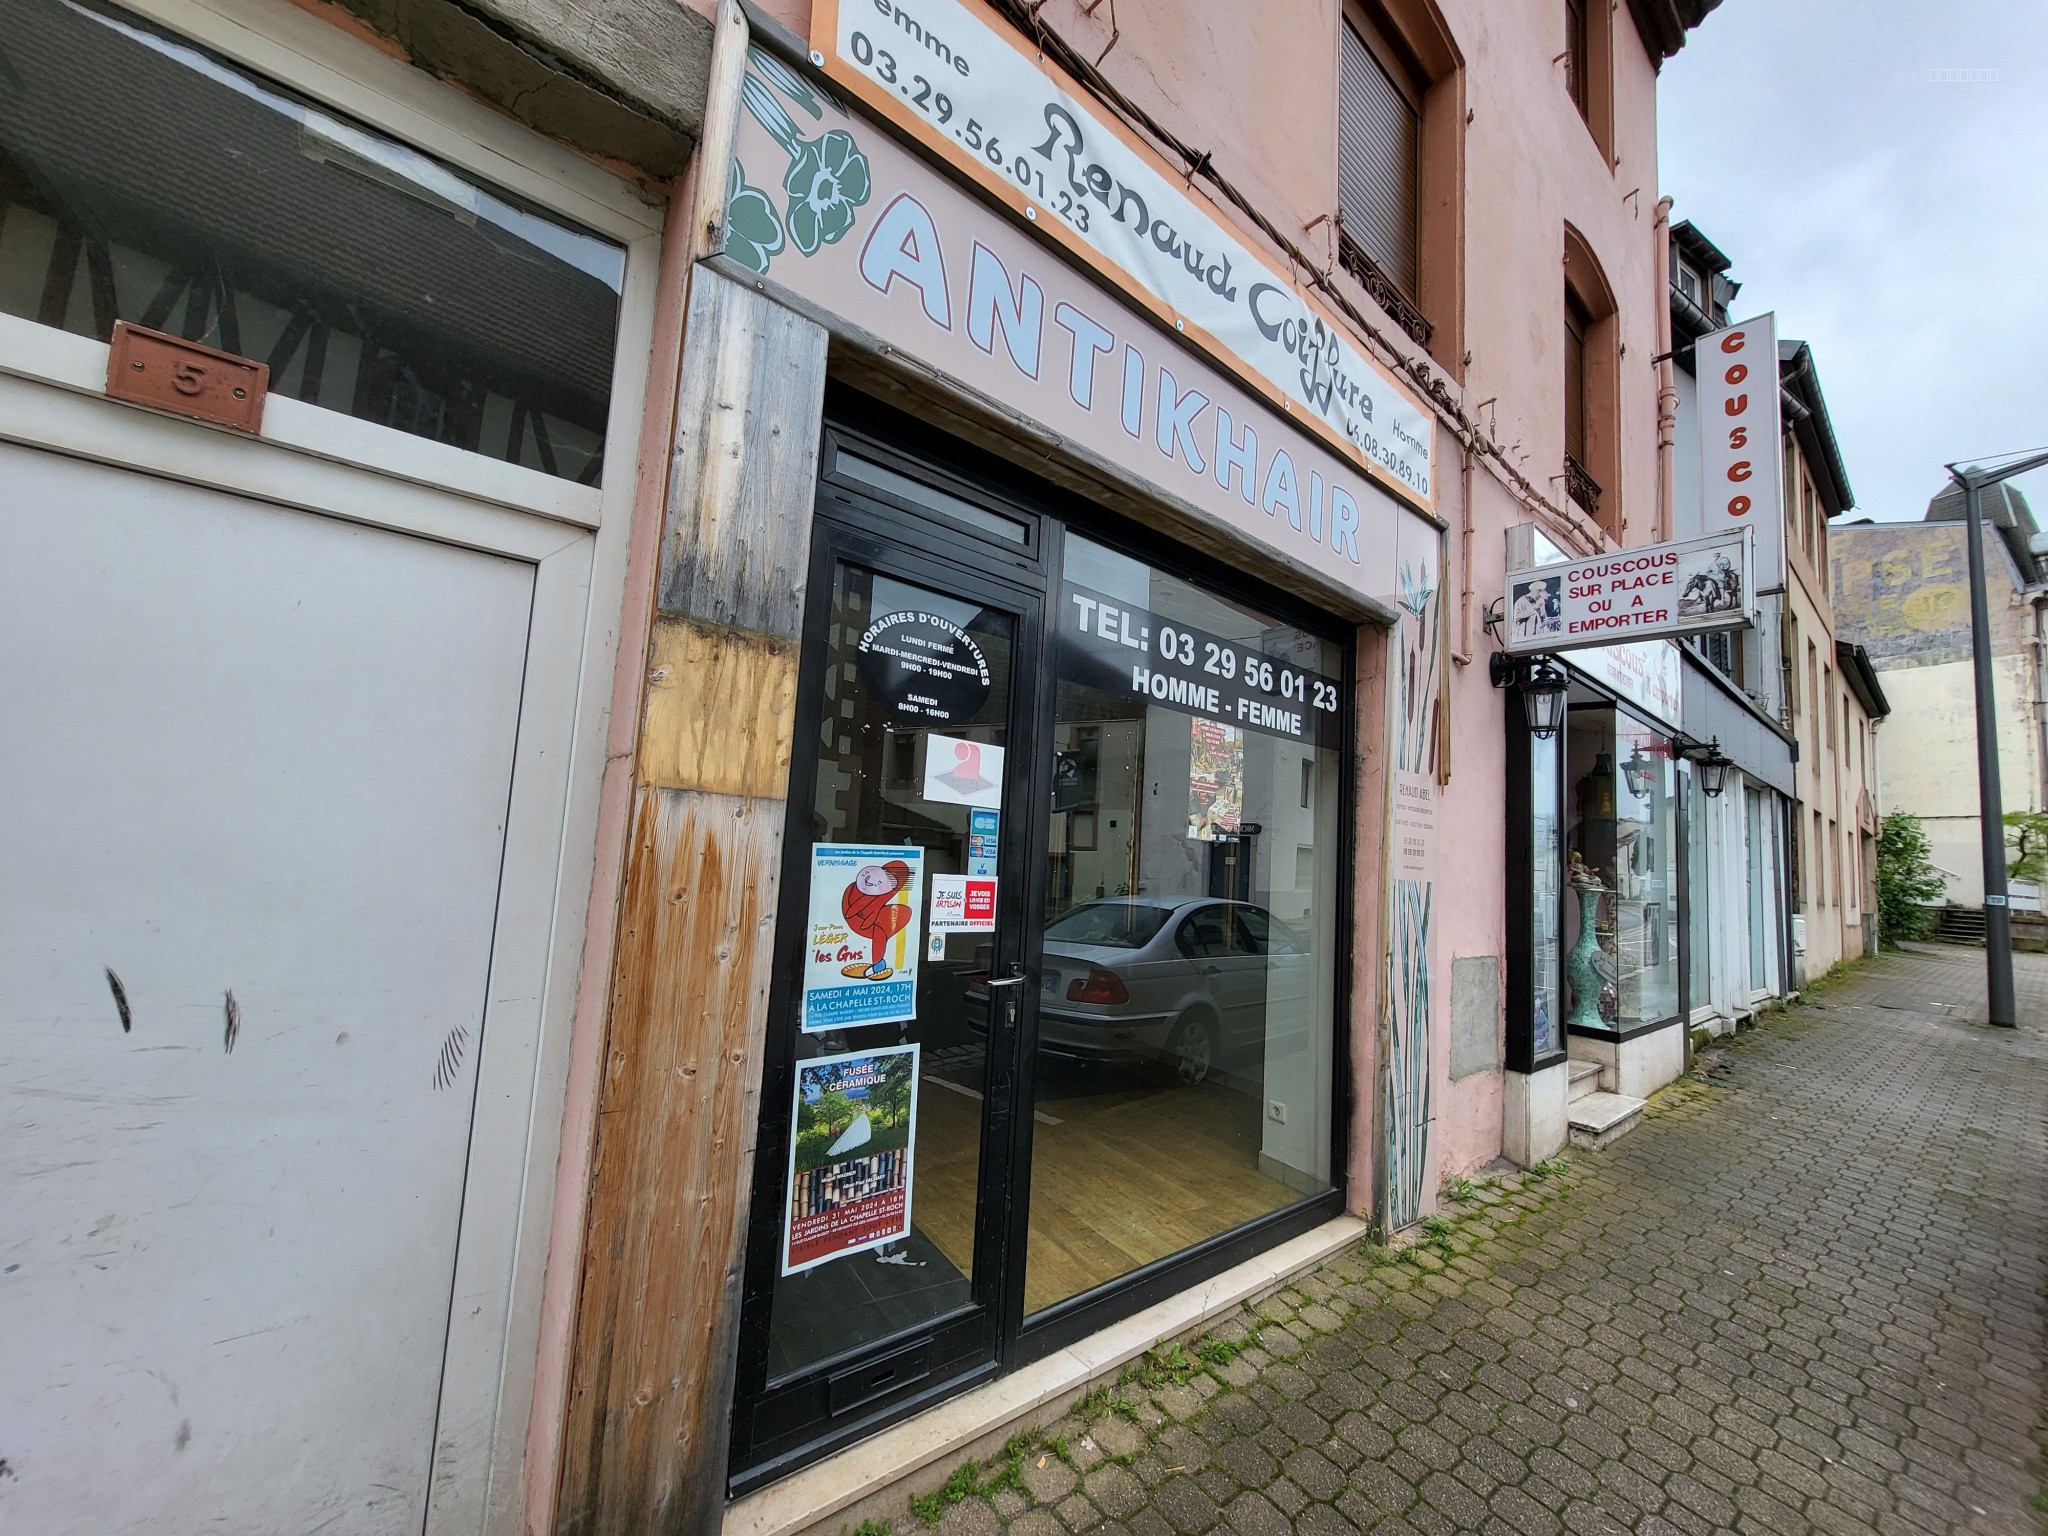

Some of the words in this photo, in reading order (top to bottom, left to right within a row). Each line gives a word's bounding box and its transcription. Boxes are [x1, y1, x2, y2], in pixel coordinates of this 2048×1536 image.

[1030, 103, 1237, 302] Renaud
[172, 360, 208, 396] 5
[858, 191, 1360, 564] ANTIKHAIR
[1392, 418, 1428, 460] Homme
[1568, 552, 1677, 582] COUSCOUS
[1568, 584, 1602, 599] SUR
[1611, 571, 1674, 592] PLACE
[1588, 599, 1612, 613] OU
[1631, 595, 1644, 607] A
[1569, 609, 1668, 634] EMPORTER
[859, 612, 915, 653] HORAIRES
[919, 612, 990, 686] D'OUVERTURES
[901, 634, 926, 647] LUNDI
[928, 641, 954, 655] FERMÉ
[1072, 593, 1149, 652] TEL:
[1159, 626, 1195, 667] 03
[1204, 642, 1236, 680] 29
[1244, 656, 1273, 692] 56
[1280, 669, 1304, 702] 01
[1313, 681, 1338, 712] 23
[872, 644, 978, 676] MARDI-MERCREDI-VENDREDI
[901, 661, 922, 673] 9H00
[928, 668, 953, 680] 19H00
[898, 703, 918, 713] 8H00
[925, 708, 950, 719] 16H00
[907, 693, 938, 706] SAMEDI
[1132, 665, 1219, 714] HOMME
[1237, 697, 1302, 736] FEMME
[817, 859, 858, 867] VERNISSAGE
[809, 990, 842, 1001] SAMEDI
[845, 989, 850, 997] 4
[852, 987, 869, 996] MAI
[870, 985, 893, 995] 2024,
[896, 983, 911, 992] 17H
[816, 1003, 828, 1012] LA
[829, 997, 872, 1010] CHAPELLE
[873, 994, 911, 1005] ST-ROCH
[829, 1074, 887, 1092] CÉRAMIQUE
[843, 1064, 874, 1077] FUSÉE
[792, 1215, 829, 1231] VENDREDI
[844, 1207, 858, 1216] MAI
[861, 1201, 878, 1211] 2024
[792, 1232, 802, 1240] LES
[803, 1223, 829, 1237] JARDINS
[831, 1220, 839, 1228] DE
[841, 1217, 848, 1225] LA
[850, 1209, 877, 1222] CHAPELLE
[878, 1202, 904, 1214] ST-ROCH
